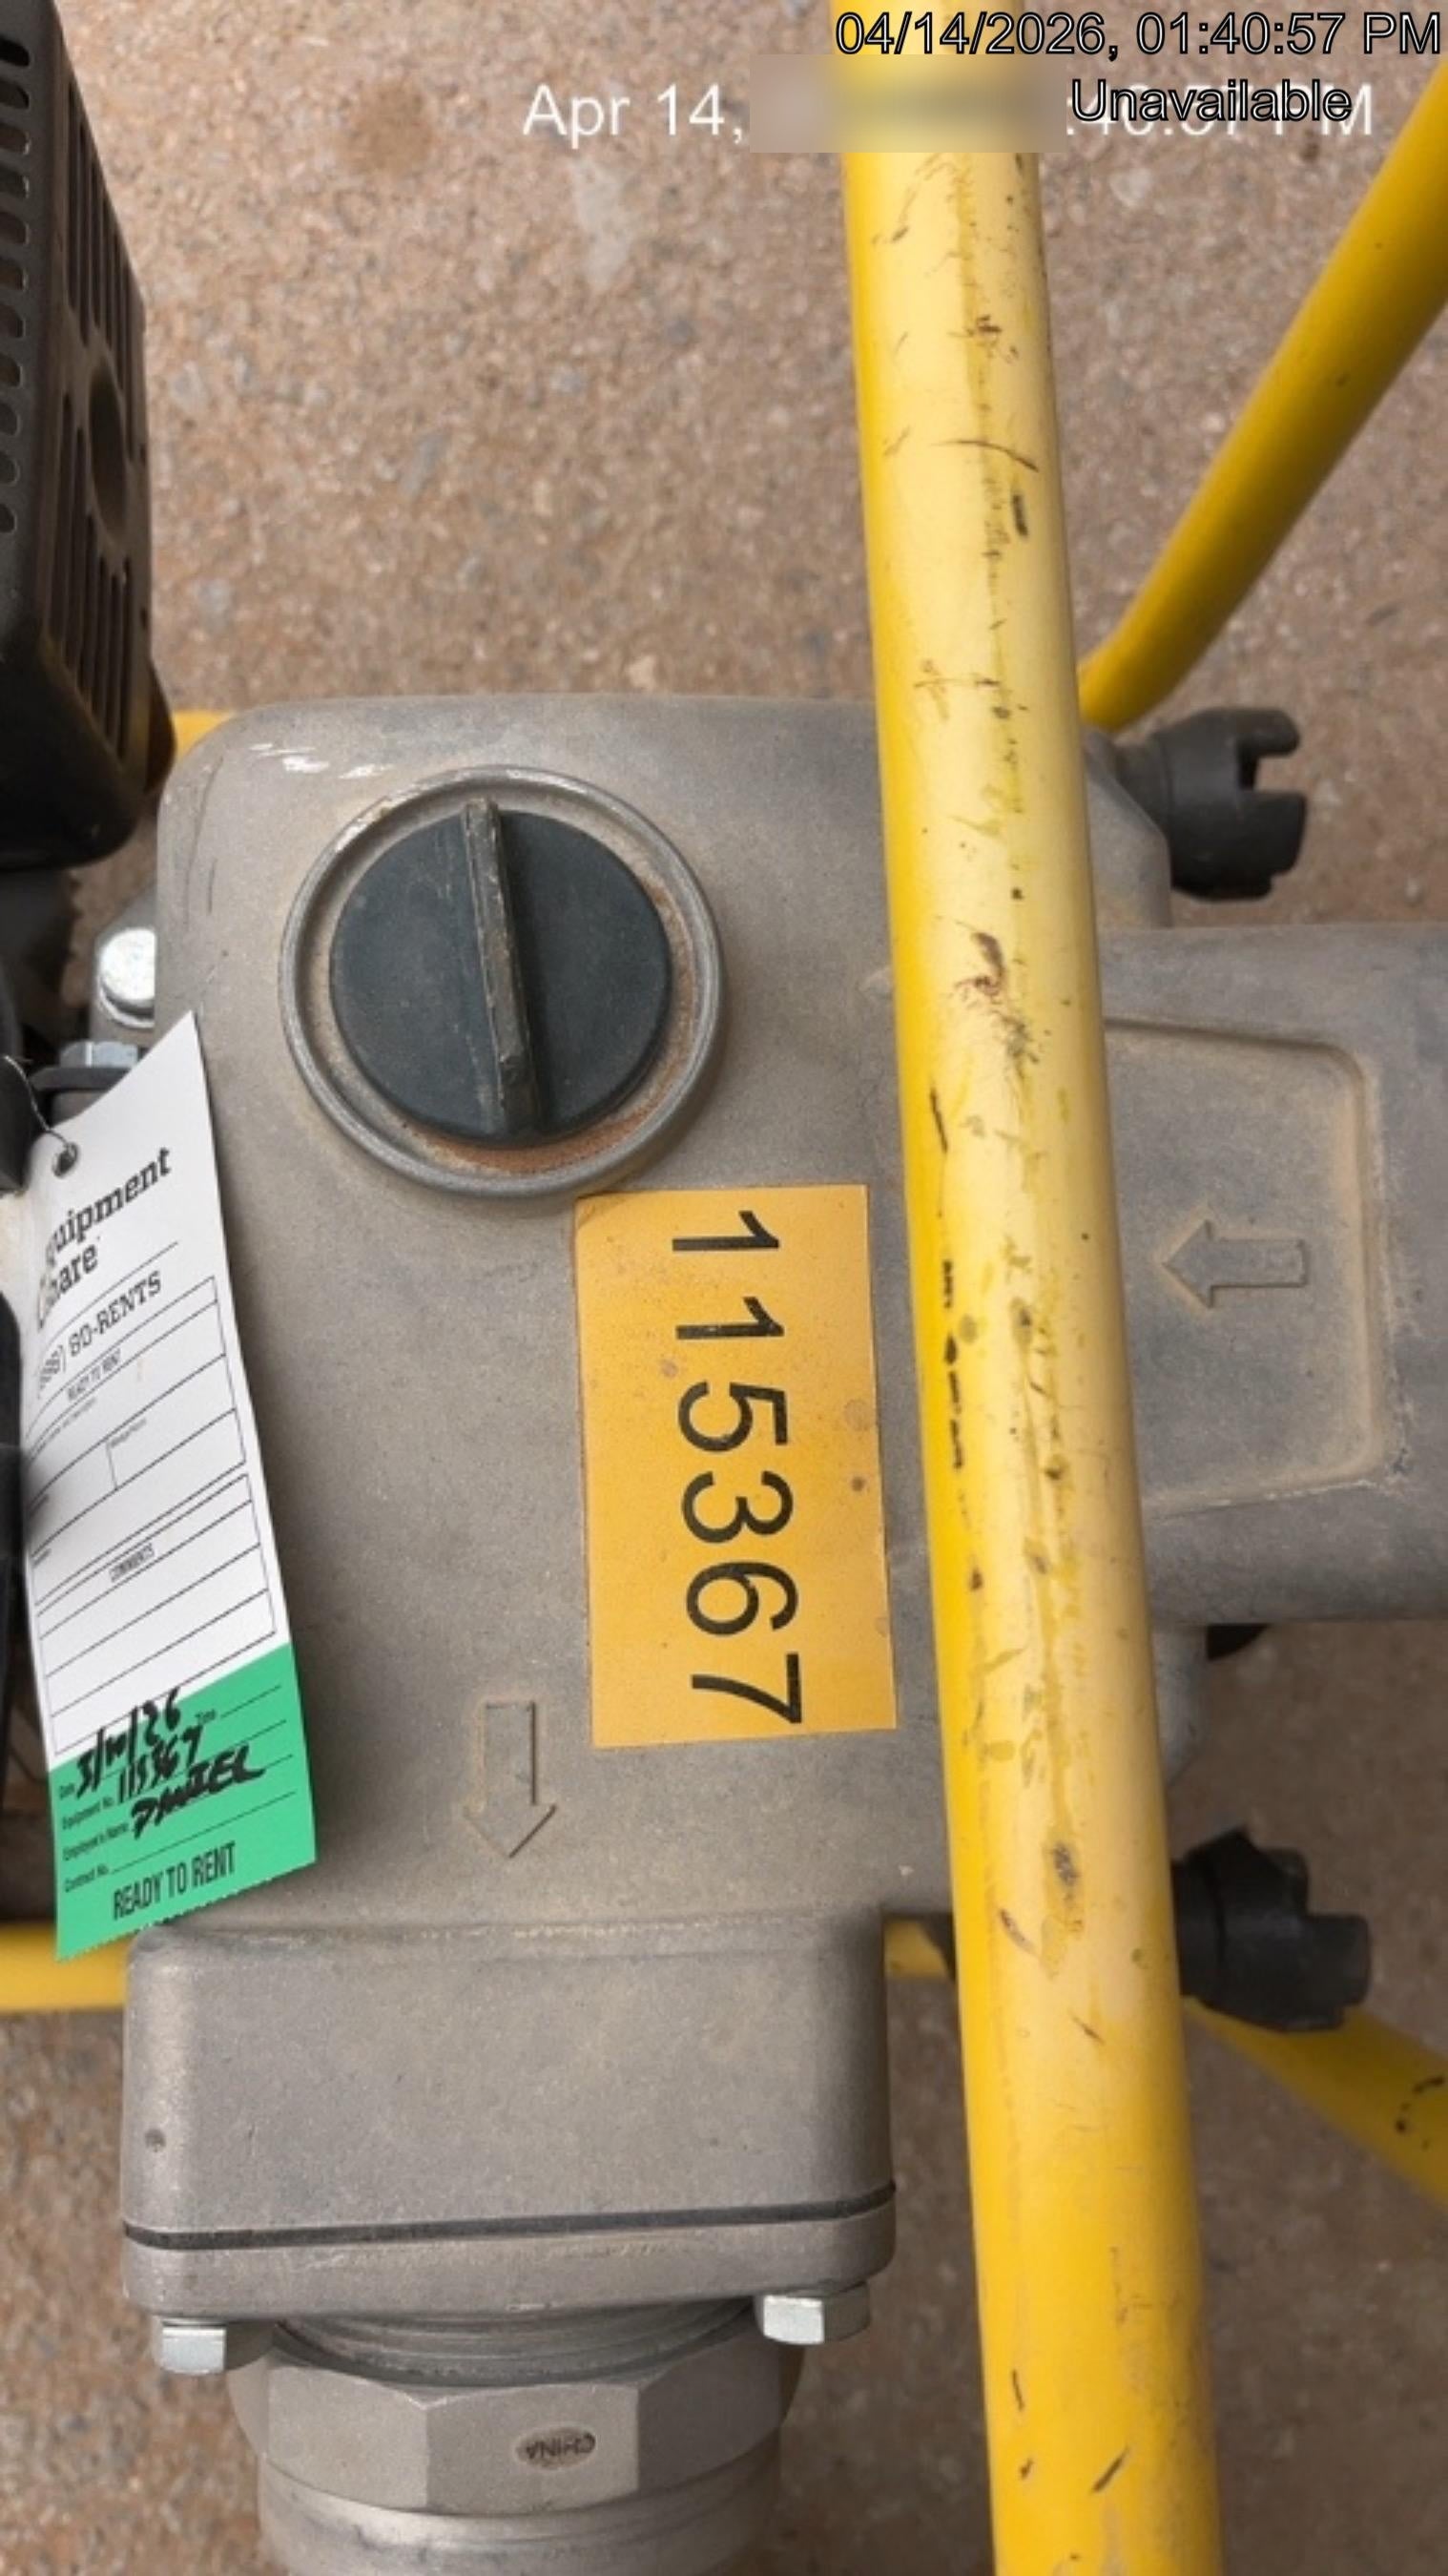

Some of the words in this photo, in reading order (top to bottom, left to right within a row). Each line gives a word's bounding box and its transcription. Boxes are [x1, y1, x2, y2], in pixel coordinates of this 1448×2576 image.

[672, 1210, 802, 1724] 115367
[114, 1872, 164, 1921] READY
[165, 1861, 187, 1897] TO
[192, 1840, 236, 1888] RENT
